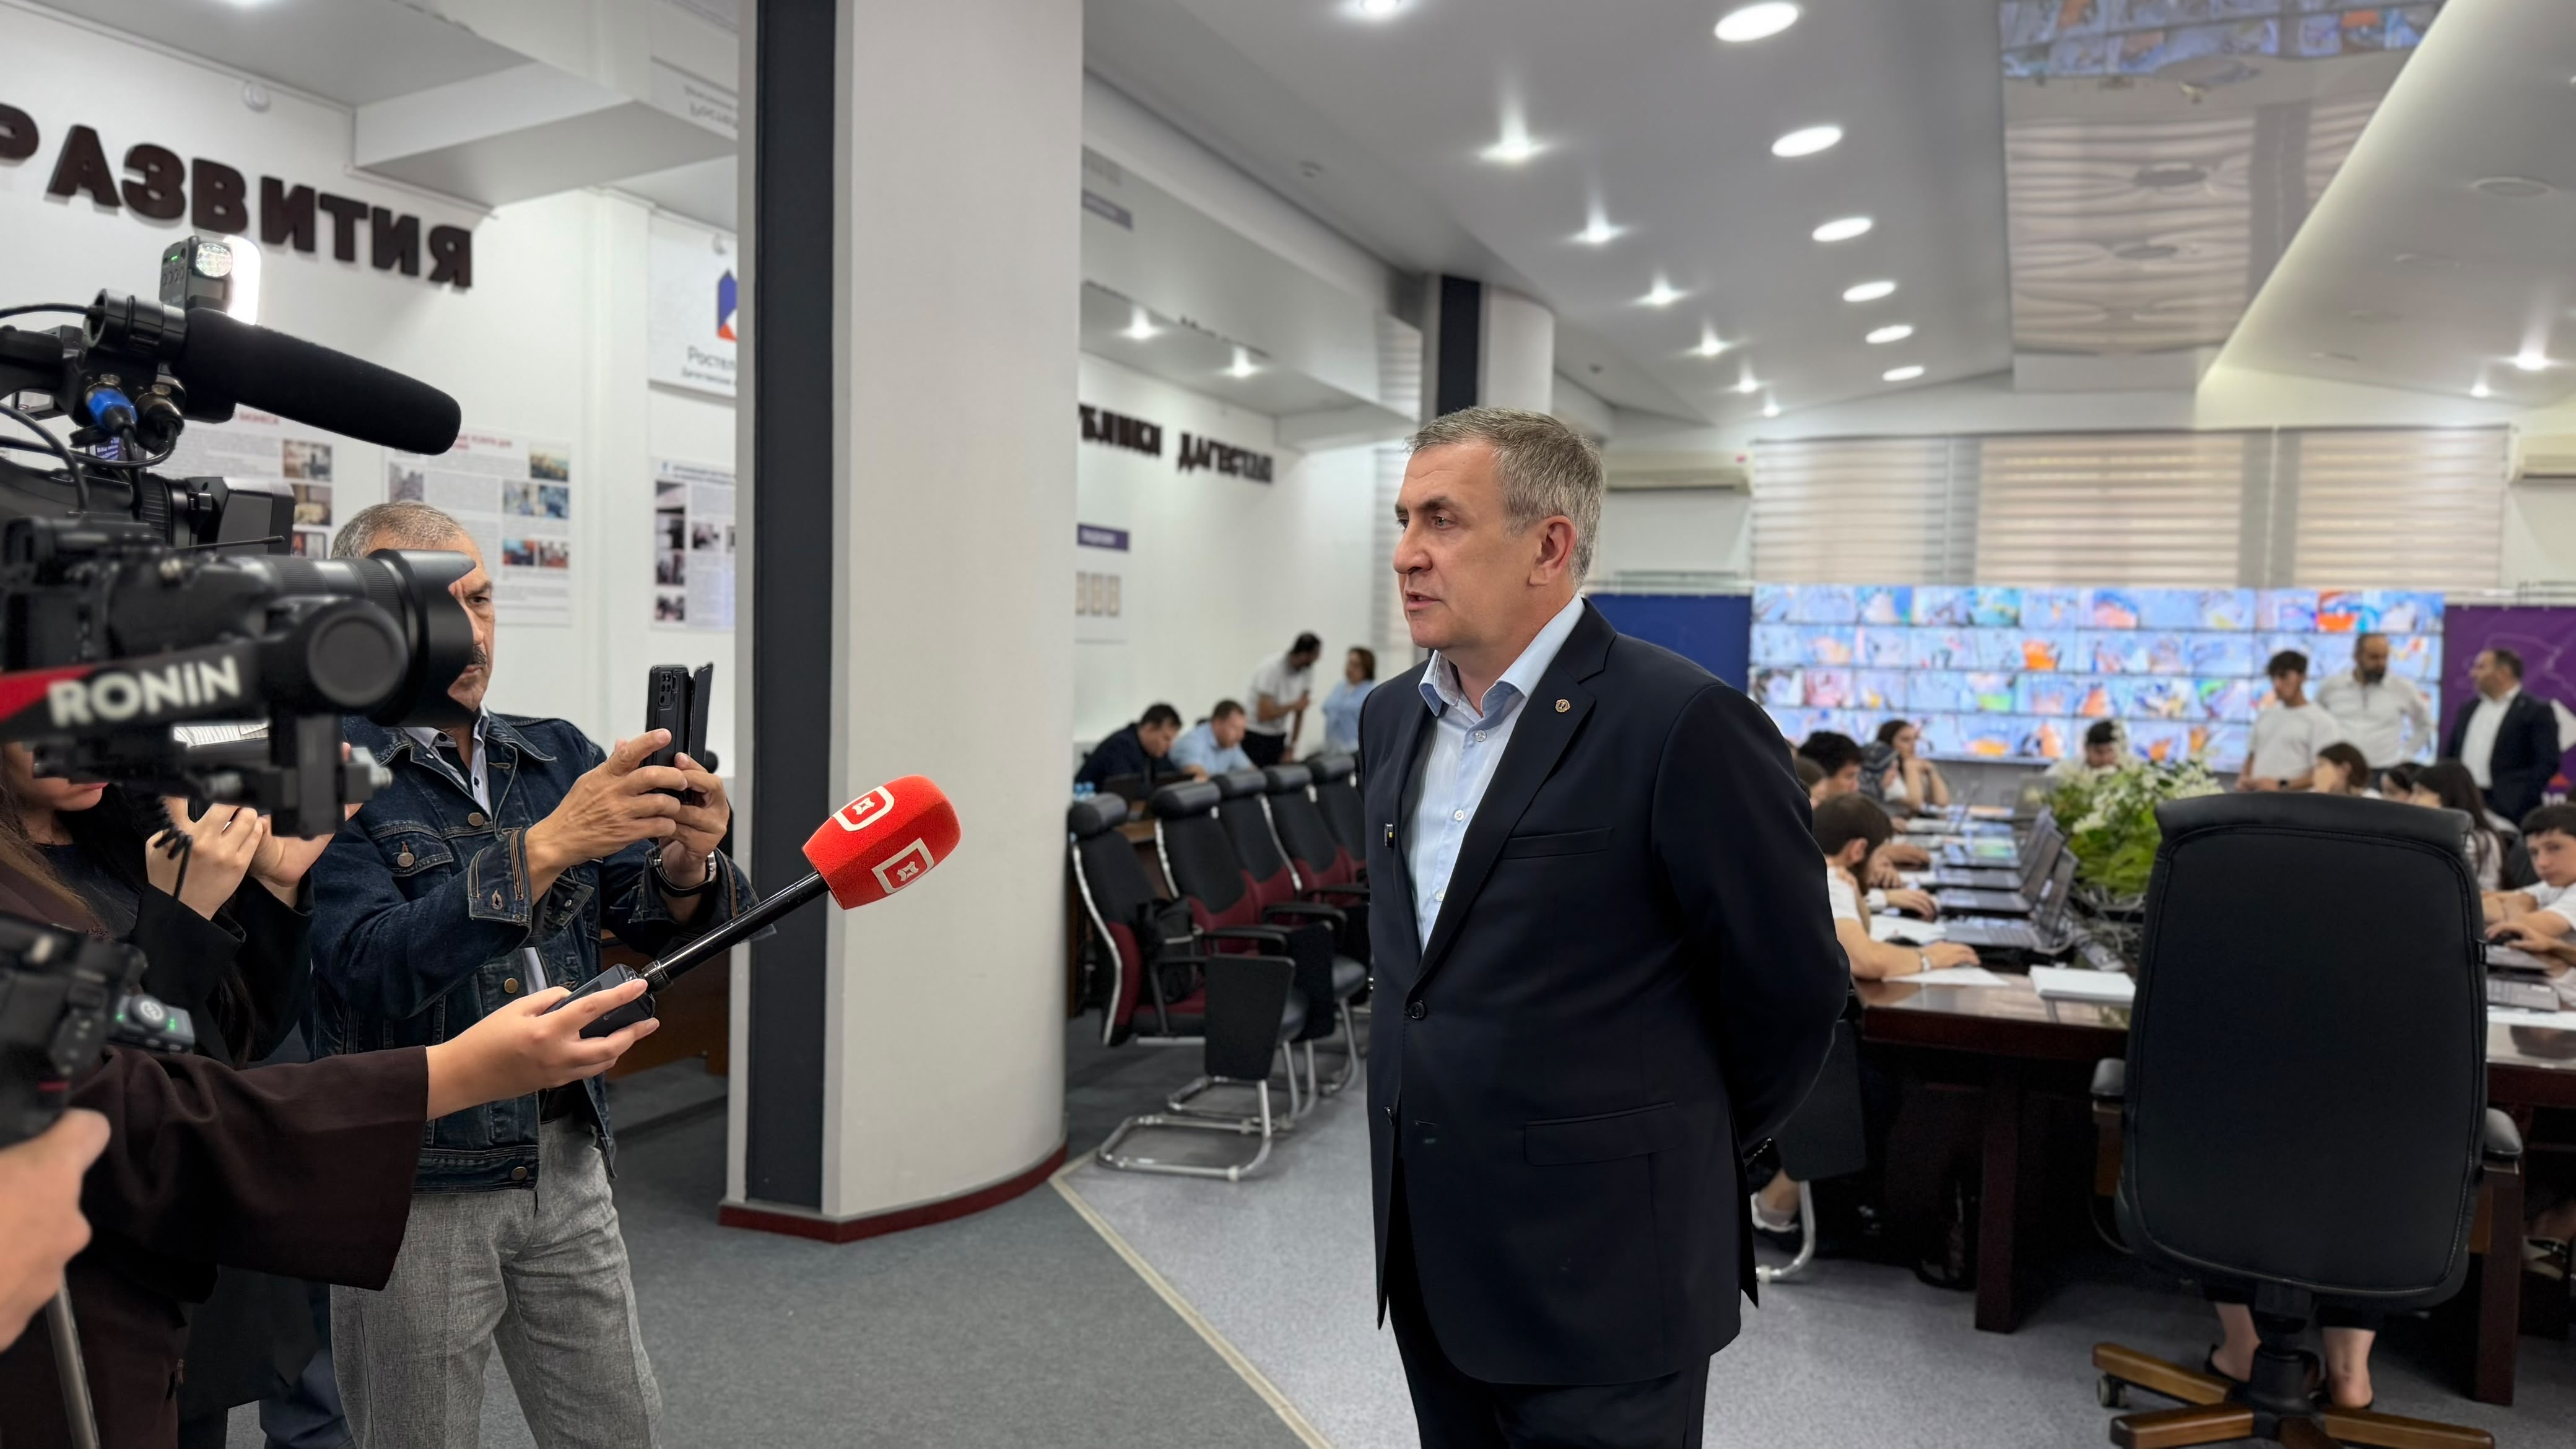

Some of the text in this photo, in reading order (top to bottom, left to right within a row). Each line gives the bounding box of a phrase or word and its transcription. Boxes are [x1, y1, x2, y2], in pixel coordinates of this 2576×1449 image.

[0, 103, 472, 288] РАЗВИТИЯ
[1079, 402, 1161, 457] БЛИКИ
[49, 655, 240, 727] RONIN
